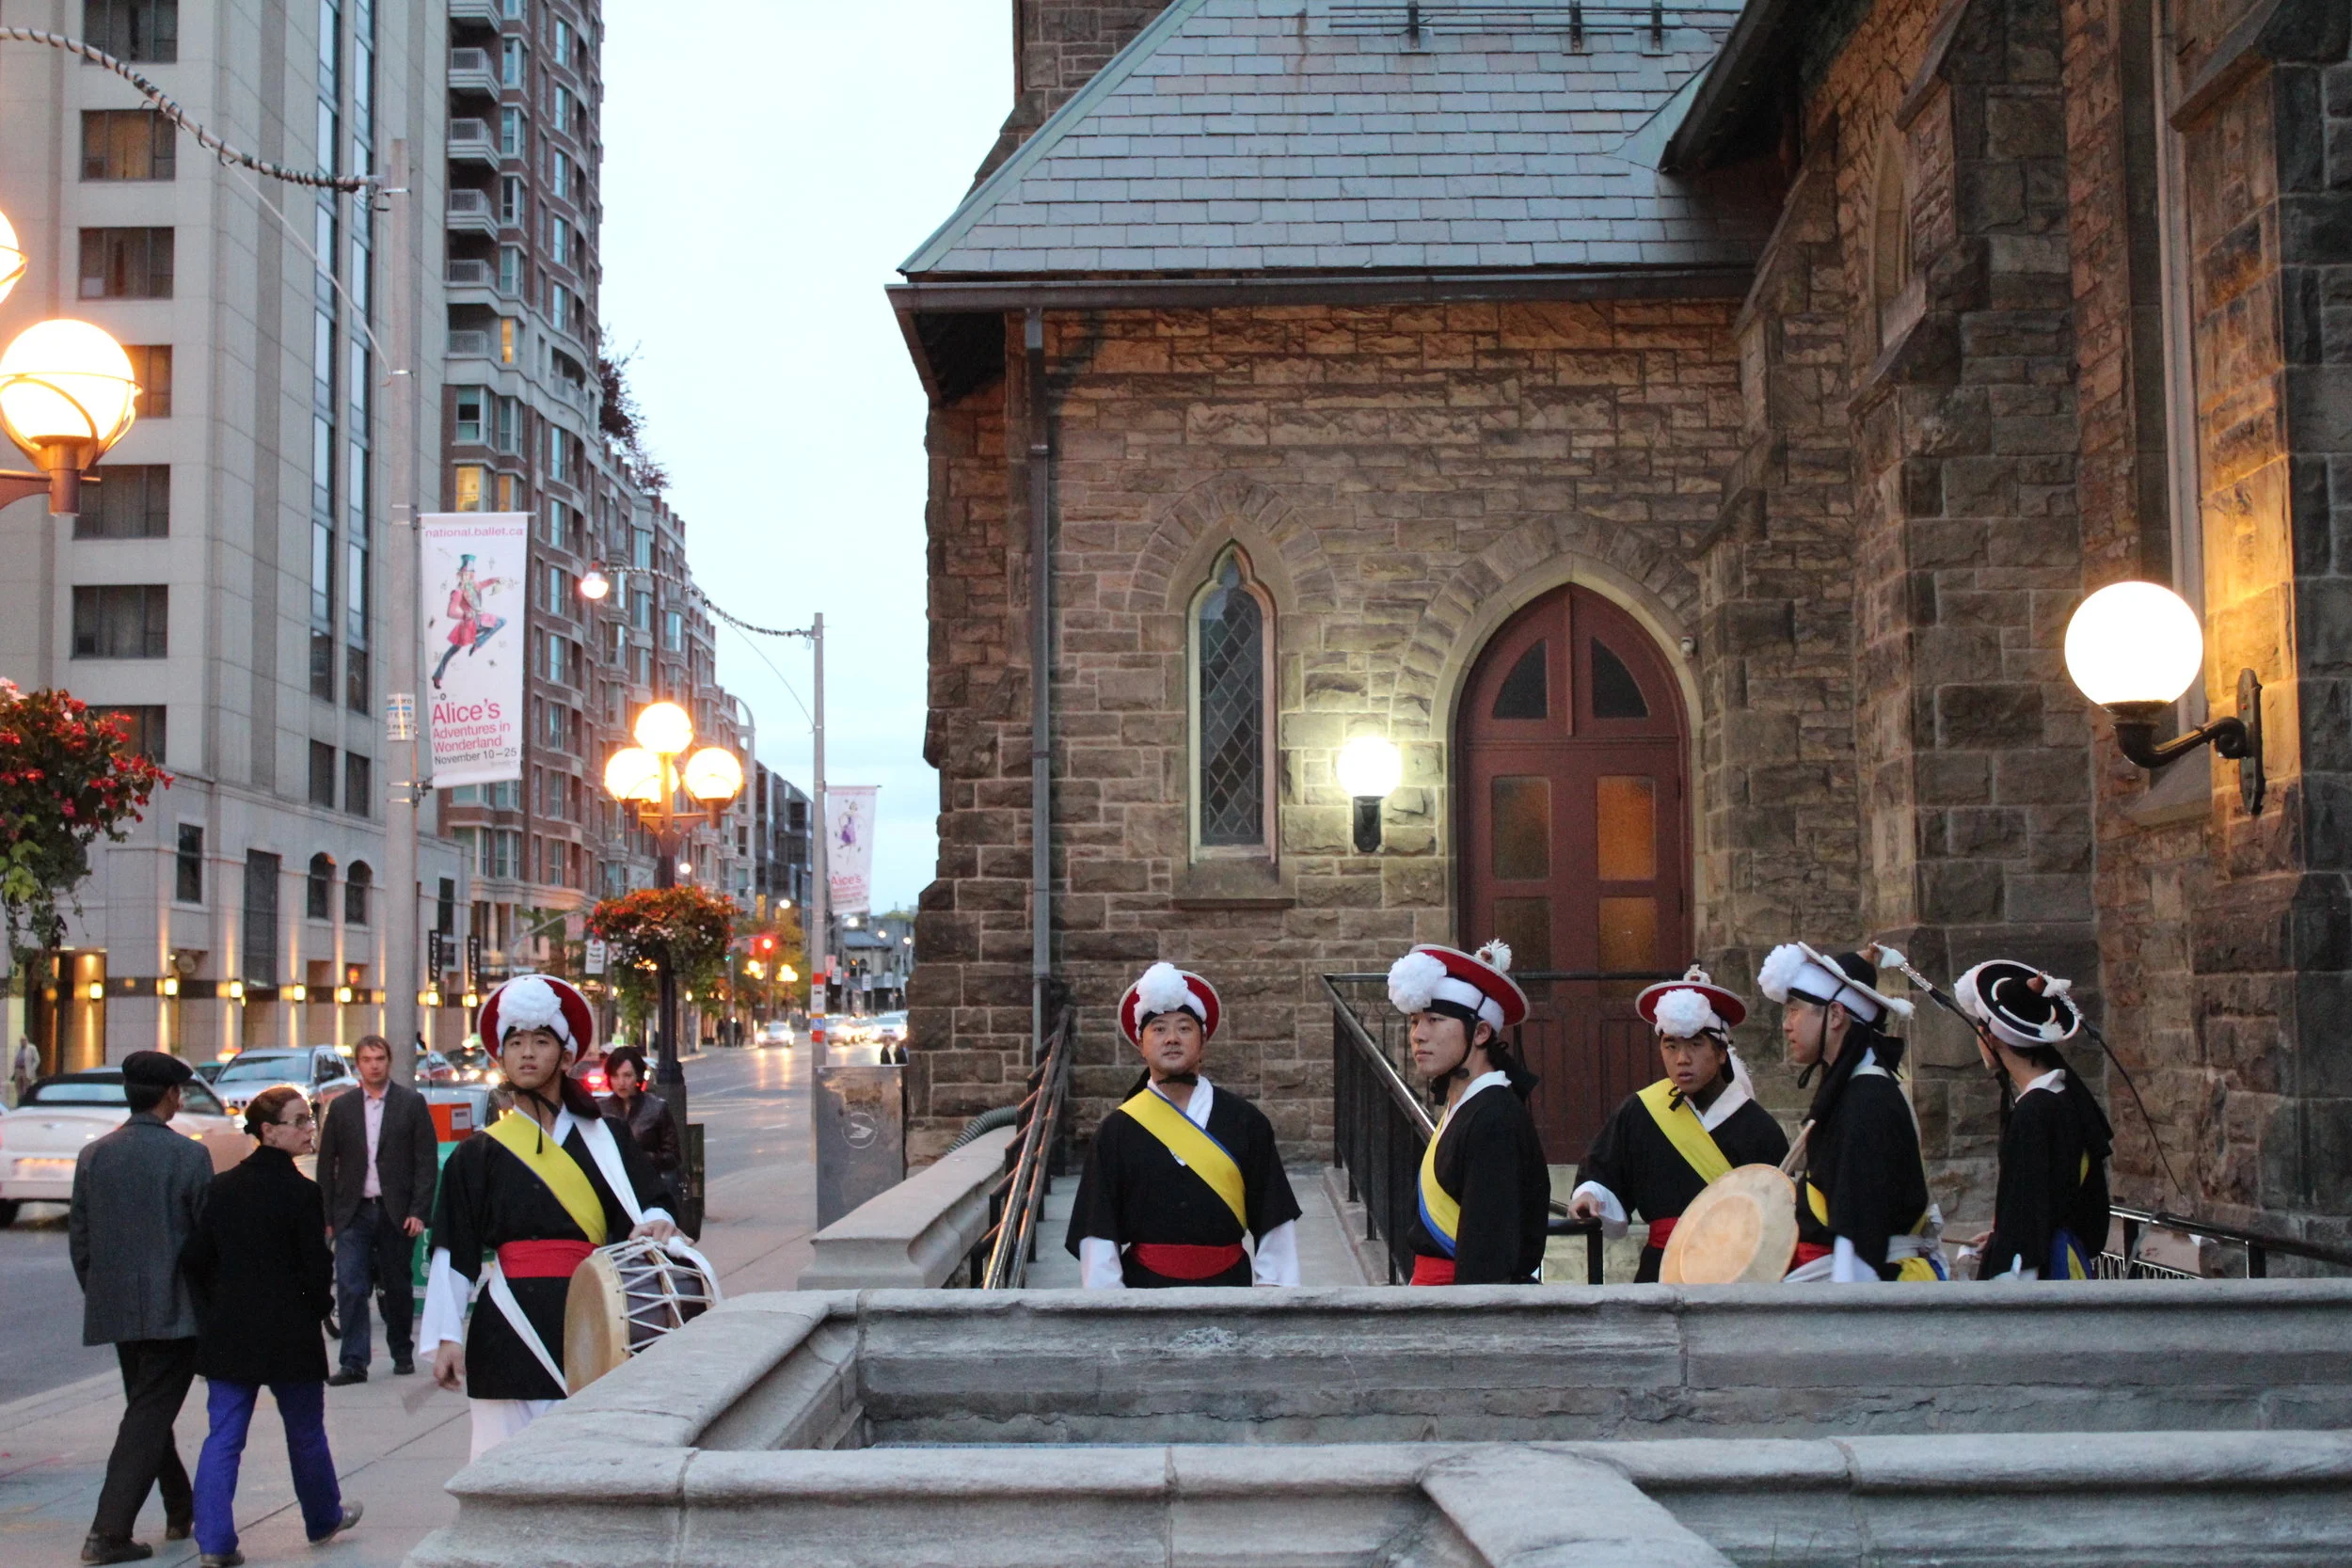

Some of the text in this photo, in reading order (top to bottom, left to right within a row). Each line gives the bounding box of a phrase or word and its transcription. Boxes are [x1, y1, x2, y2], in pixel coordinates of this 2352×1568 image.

[425, 527, 523, 538] national.ballet.ca
[432, 698, 501, 725] Alice's
[433, 721, 511, 739] Adventures in
[434, 735, 502, 753] Wonderland
[435, 752, 480, 766] November
